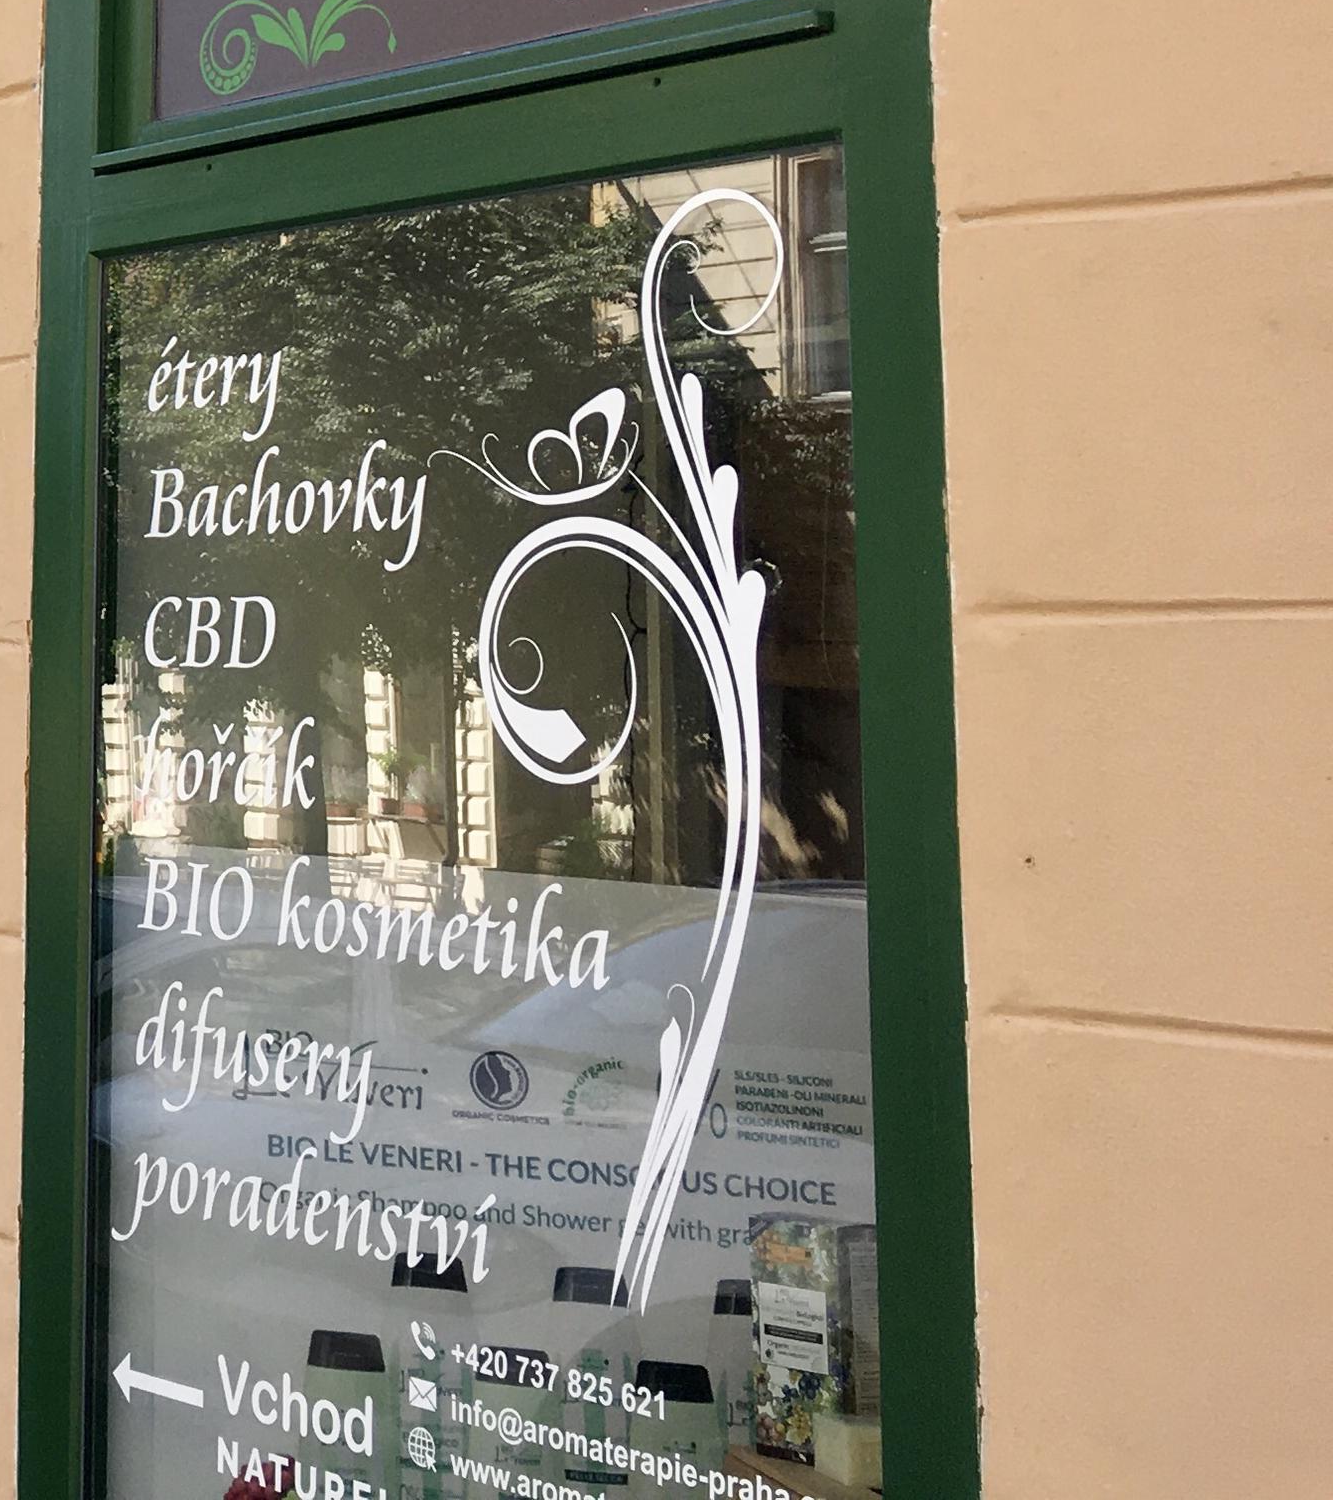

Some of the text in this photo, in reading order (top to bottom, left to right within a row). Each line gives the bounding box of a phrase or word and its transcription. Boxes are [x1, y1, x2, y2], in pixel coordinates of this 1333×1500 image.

[147, 335, 283, 443] étery
[144, 438, 431, 573] Bachovky
[144, 595, 276, 669] CBD
[132, 715, 317, 810] hořčík
[137, 856, 613, 992] BIO kosmetika
[134, 981, 374, 1145] difusery
[111, 1147, 497, 1284] poradenství
[323, 1136, 354, 1165] LE
[360, 1142, 463, 1174] VENERI
[484, 1152, 542, 1181] THE
[724, 1173, 838, 1207] CHOICE
[522, 1204, 613, 1233] Shower
[216, 1353, 374, 1458] Vchod
[450, 1342, 666, 1421] +420 737 825 621
